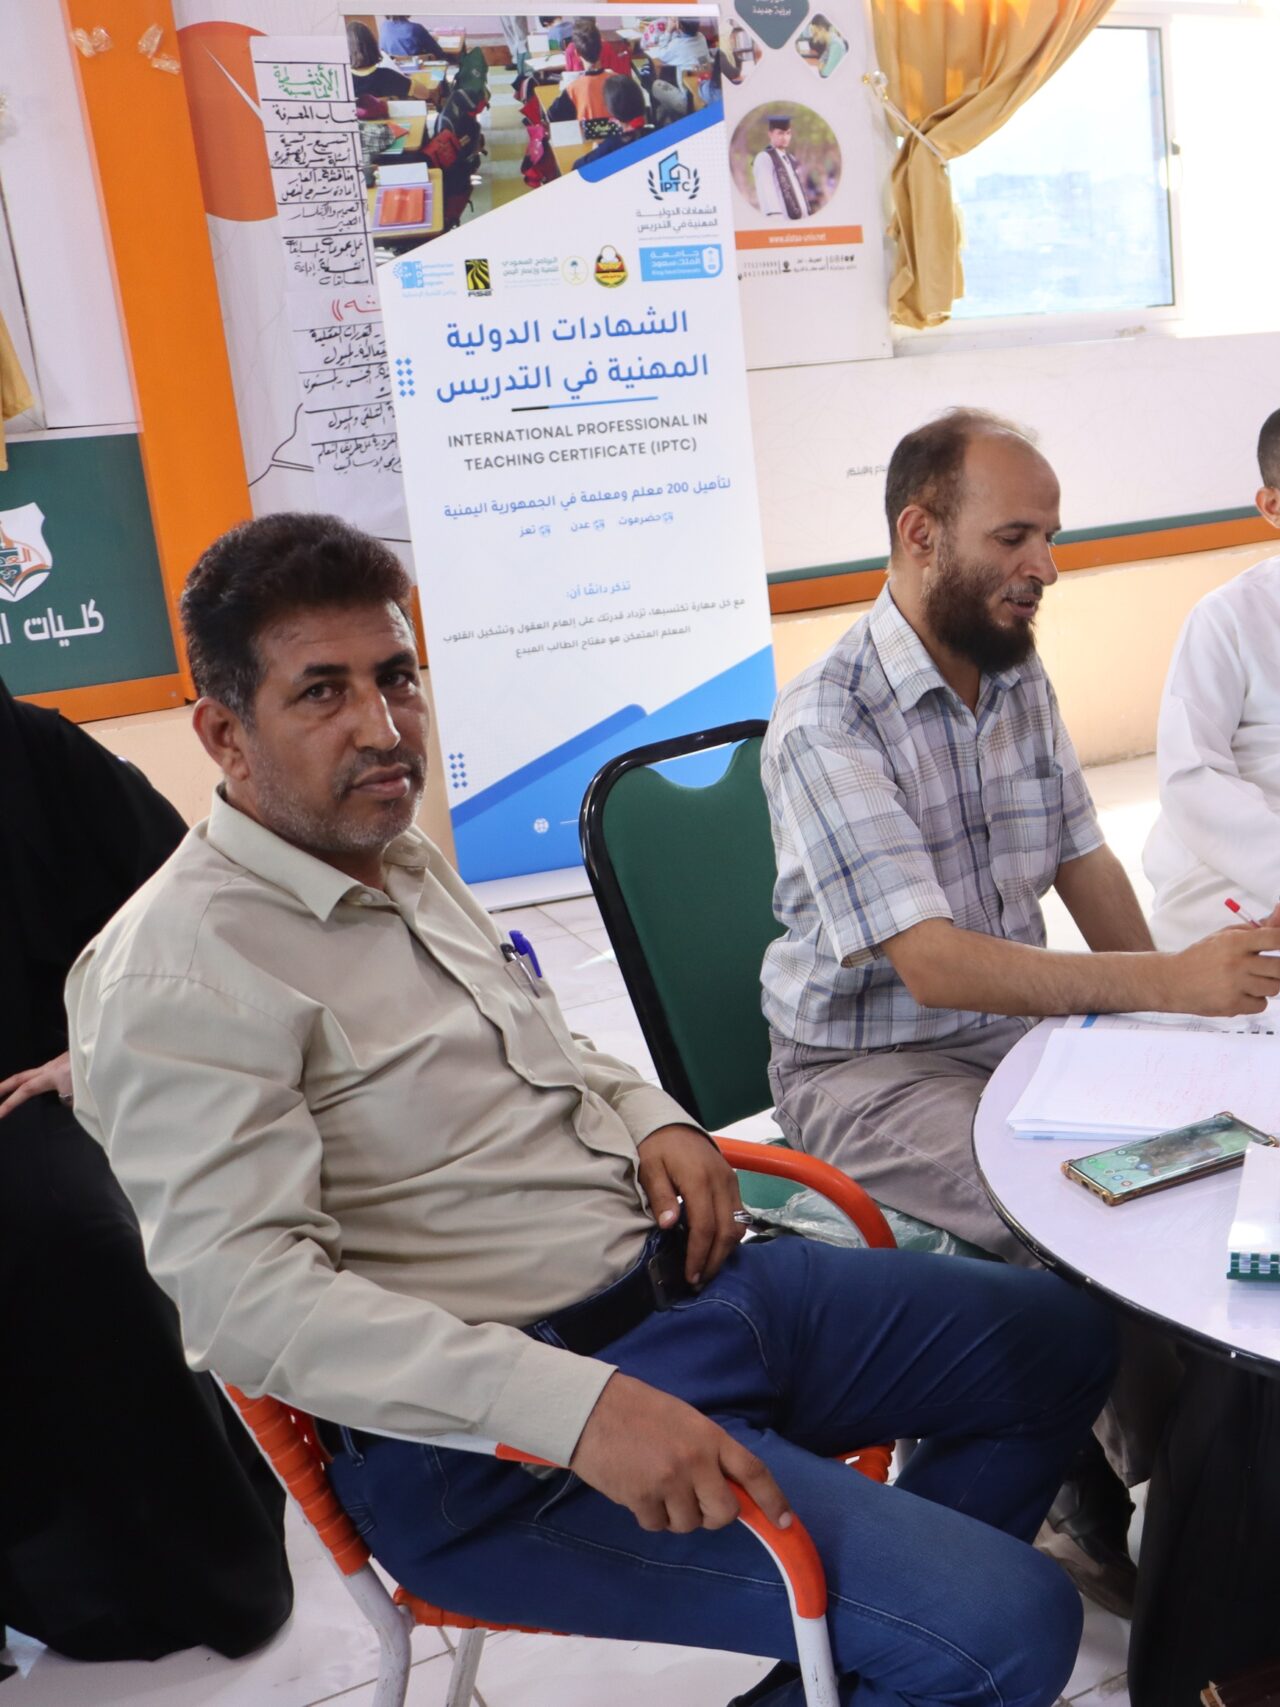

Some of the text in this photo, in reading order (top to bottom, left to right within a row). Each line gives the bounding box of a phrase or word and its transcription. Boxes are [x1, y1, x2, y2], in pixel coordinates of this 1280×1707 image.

[272, 104, 314, 125] المعرفة
[660, 181, 691, 193] IPTC
[681, 205, 717, 216] الشهادات
[447, 305, 688, 356] الشهادات الدولية
[437, 353, 709, 404] المهنية في التدريس
[448, 412, 708, 448] INTERNATIONAL PROFESSIONAL IN
[464, 437, 697, 471] TEACHING CERTIFICATE (IPTC)
[444, 475, 731, 518] لتأهيل 200 معلم ومعلمة في الجمهورية اليمنية
[570, 520, 591, 532] عدن
[618, 512, 661, 527] حضرموت
[519, 526, 536, 538] تعز
[609, 580, 631, 595] تذكر
[719, 598, 732, 609] كل
[733, 598, 746, 607] مع
[24, 599, 104, 647] كليات
[517, 621, 549, 634] العقول
[443, 627, 475, 643] القلوب
[660, 625, 692, 639] المعلم
[515, 644, 544, 658] المبدع
[547, 640, 579, 653] الطالب
